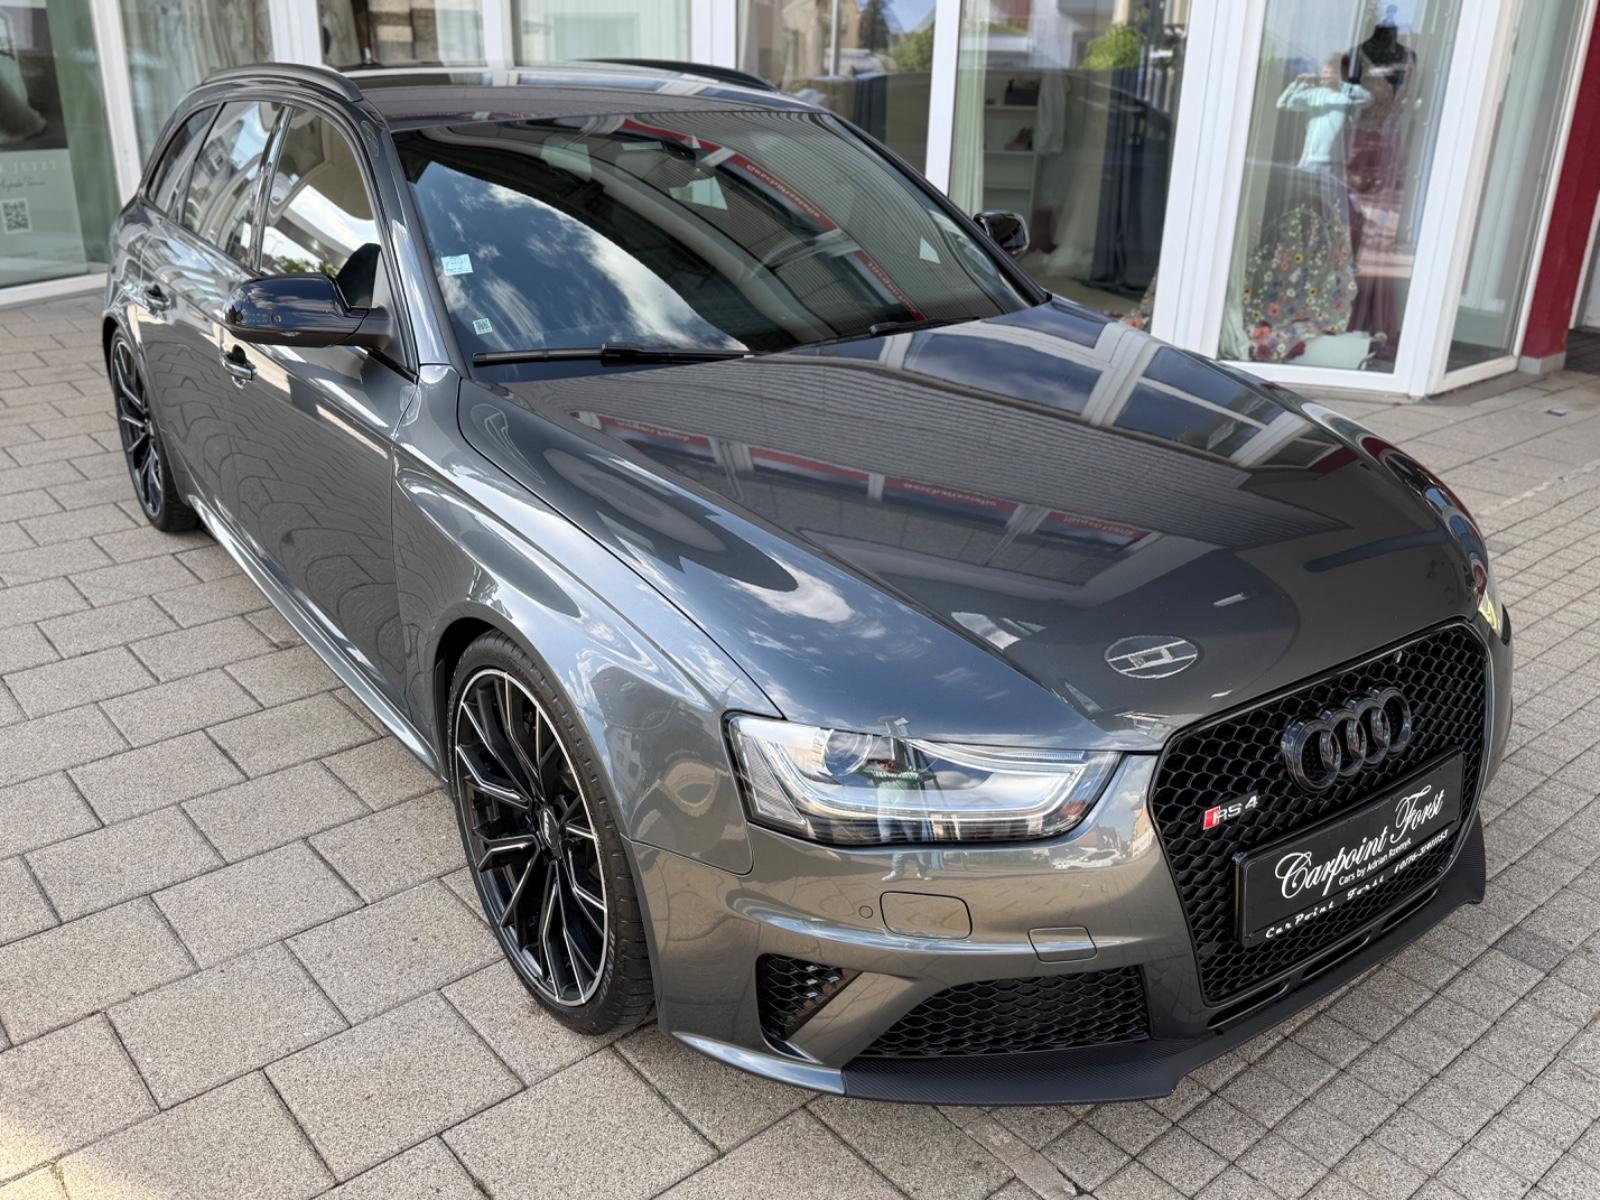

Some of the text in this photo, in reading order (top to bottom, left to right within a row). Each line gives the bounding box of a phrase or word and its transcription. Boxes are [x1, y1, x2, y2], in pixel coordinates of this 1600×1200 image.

[1275, 826, 1388, 899] Carpoint
[1390, 784, 1445, 844] Forst
[1338, 872, 1356, 886] Cars
[1356, 867, 1366, 878] by
